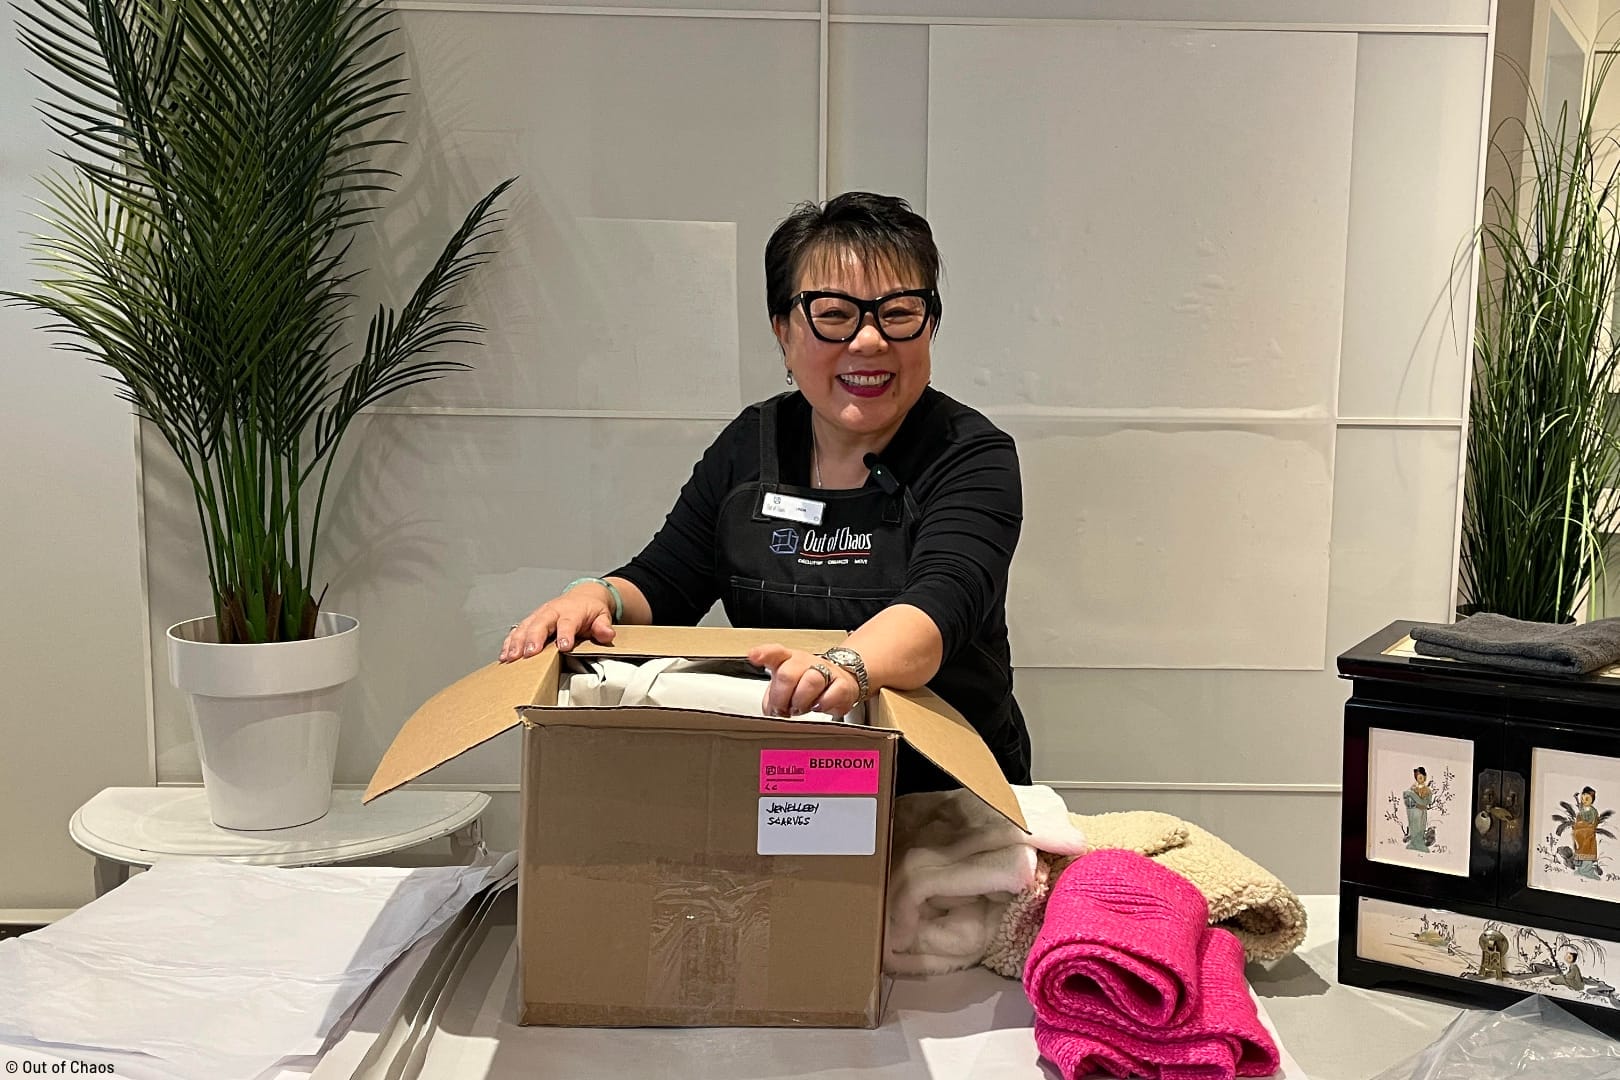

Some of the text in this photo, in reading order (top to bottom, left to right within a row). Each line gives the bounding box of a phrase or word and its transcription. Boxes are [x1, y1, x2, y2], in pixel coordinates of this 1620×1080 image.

[803, 526, 872, 552] Out of Chaos
[809, 758, 874, 769] BEDROOM
